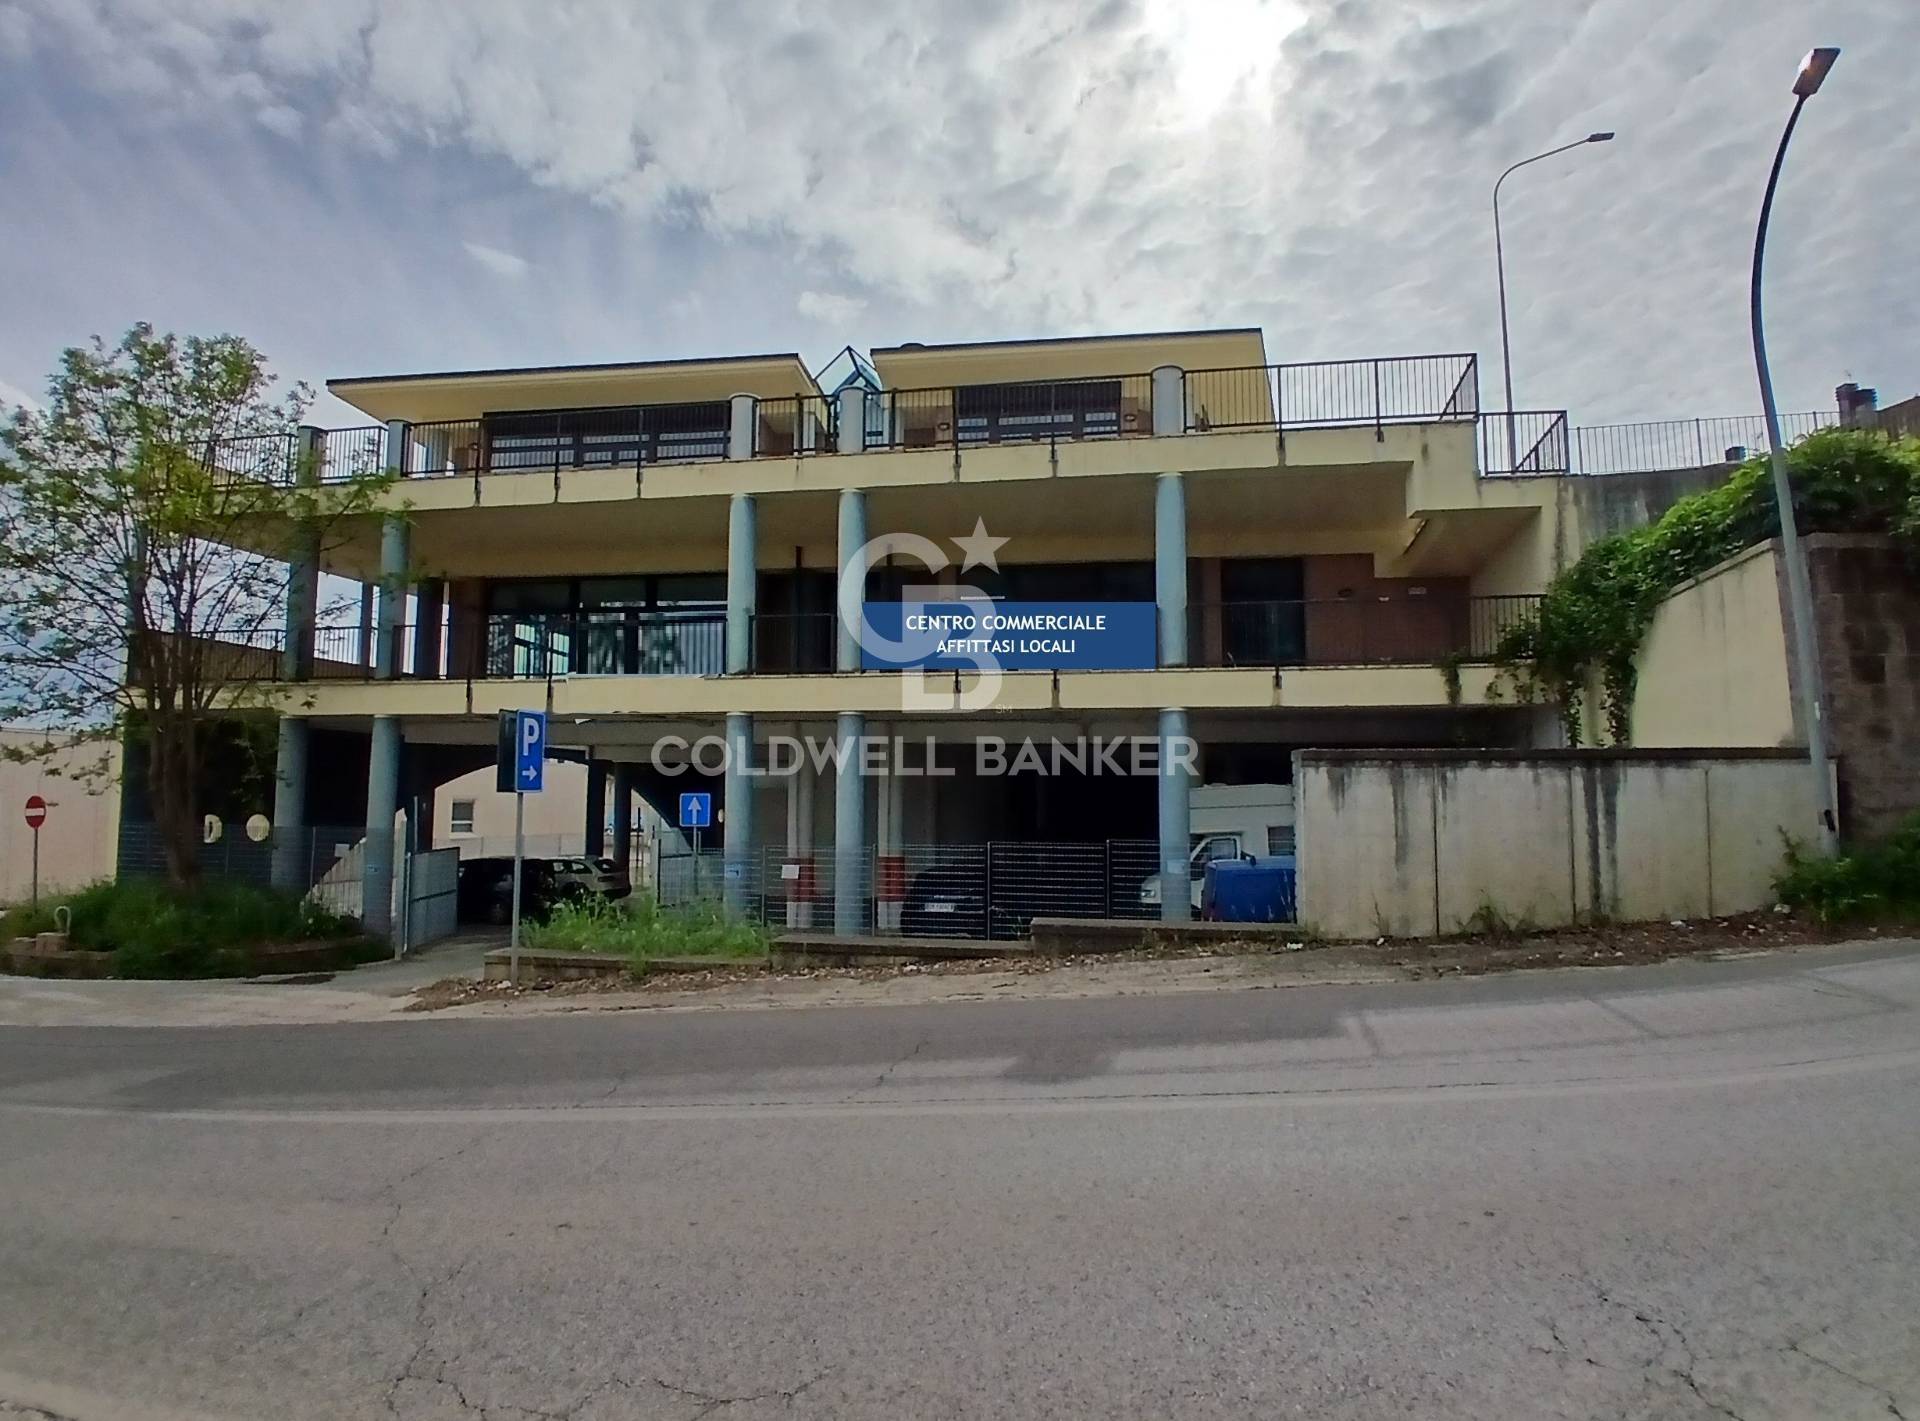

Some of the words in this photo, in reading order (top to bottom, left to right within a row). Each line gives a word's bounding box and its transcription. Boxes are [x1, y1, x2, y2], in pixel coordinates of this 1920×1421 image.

[906, 616, 976, 630] CENTRO
[983, 616, 1106, 630] COMMERCIALE
[937, 640, 1014, 652] AFFITTASI
[1021, 640, 1075, 652] LOCALI
[523, 718, 539, 755] P
